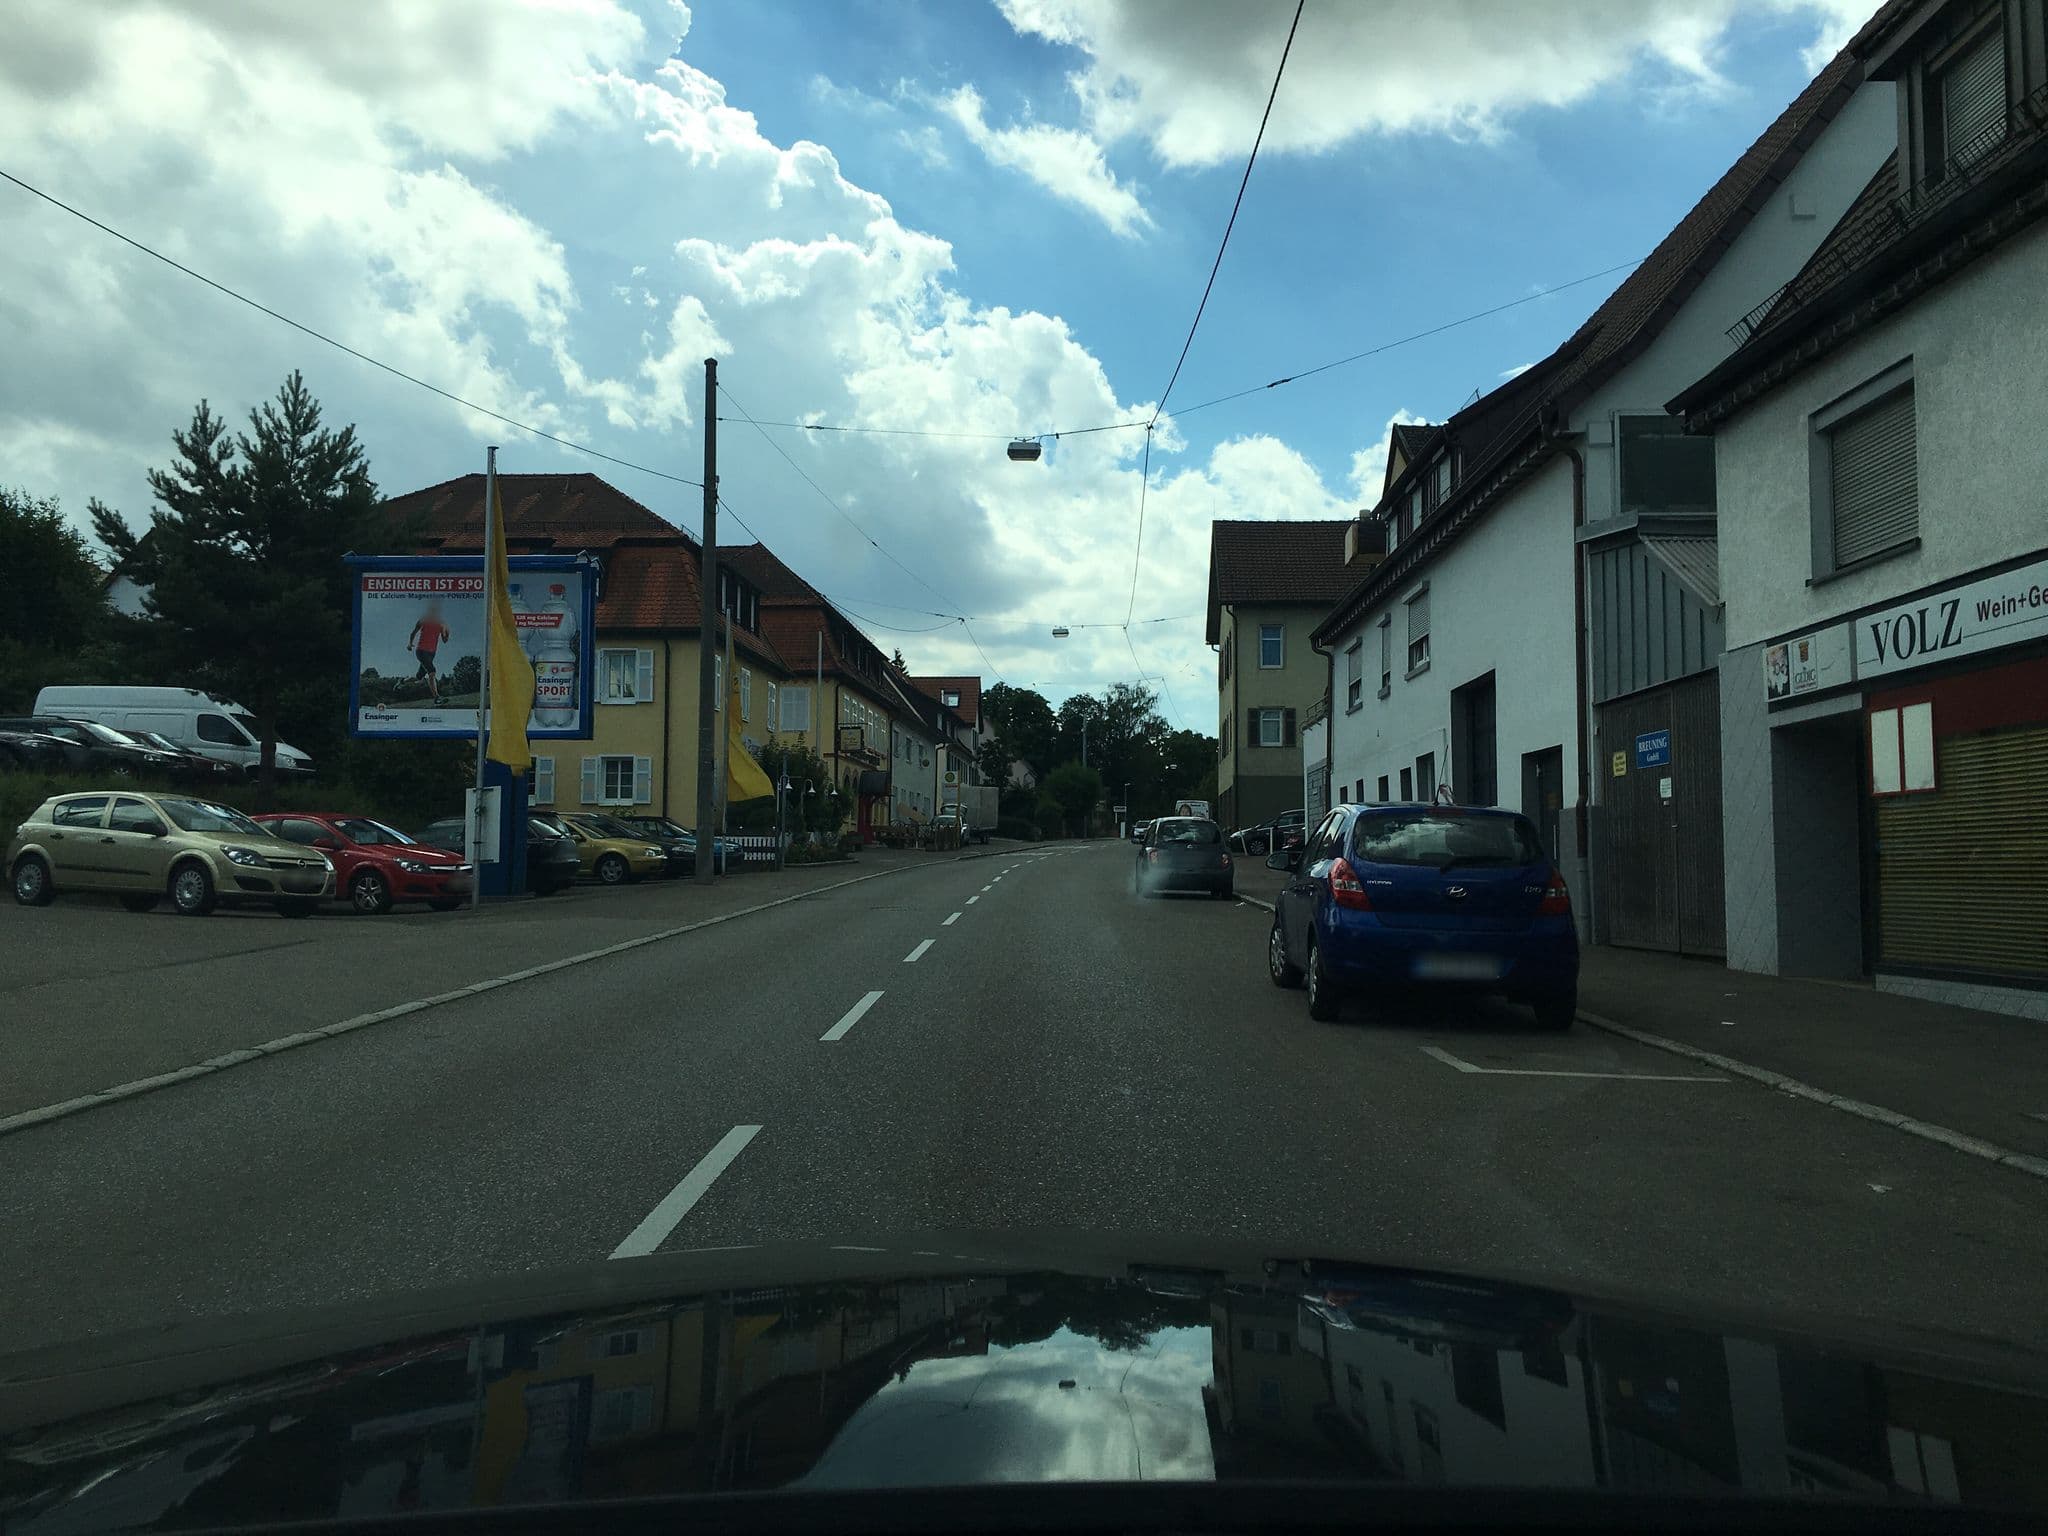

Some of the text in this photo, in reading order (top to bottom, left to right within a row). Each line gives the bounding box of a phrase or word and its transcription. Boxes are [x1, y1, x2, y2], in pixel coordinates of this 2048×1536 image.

[367, 579, 431, 590] ENSINGER
[436, 579, 454, 590] IST
[1870, 597, 1963, 666] VOLZ
[538, 676, 572, 685] Ensinger
[537, 686, 572, 696] SPORT
[364, 712, 399, 721] Ensinger
